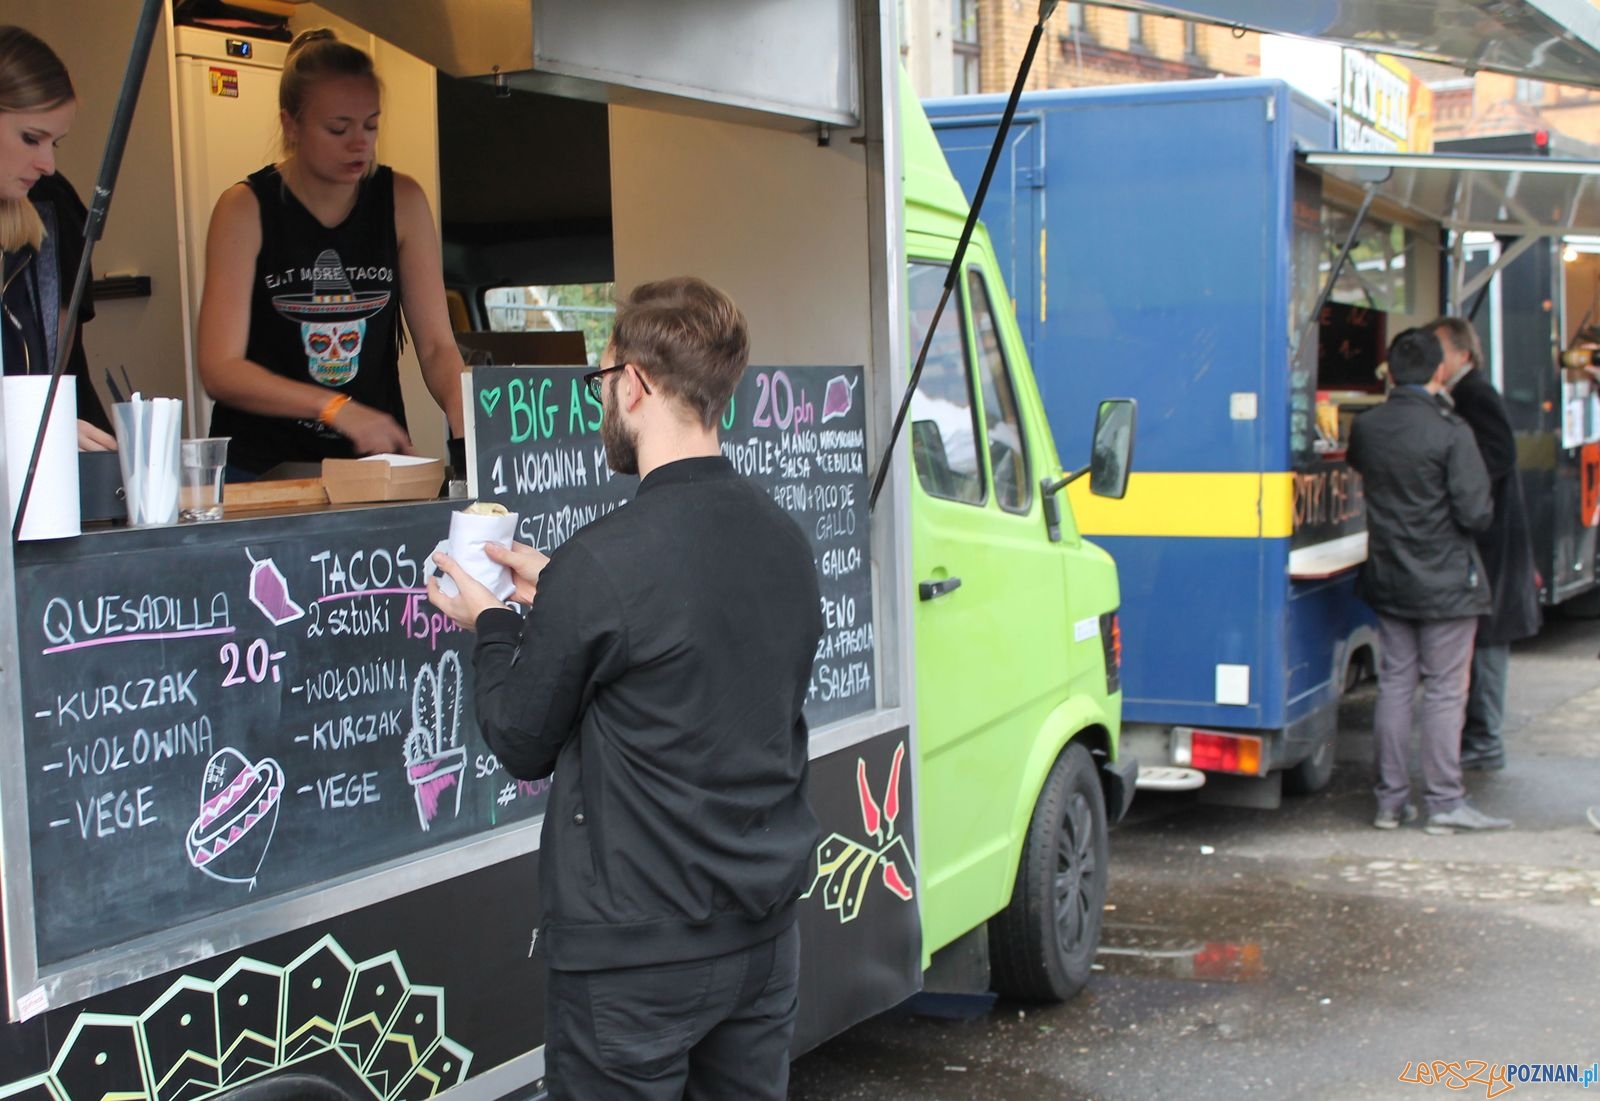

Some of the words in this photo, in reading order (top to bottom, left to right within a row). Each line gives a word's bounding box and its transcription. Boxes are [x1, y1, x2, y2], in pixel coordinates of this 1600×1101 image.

[265, 268, 295, 288] EAT
[301, 267, 343, 281] MORE
[345, 266, 393, 282] TACOS
[781, 430, 818, 457] MANGO
[491, 455, 508, 495] 1
[780, 455, 811, 479] SALSA
[839, 483, 855, 510] DE
[816, 508, 856, 540] GALLO
[310, 544, 418, 597] TACOS
[43, 591, 230, 645] QUESADILLA
[306, 600, 324, 638] 2
[327, 597, 390, 638] sztuki
